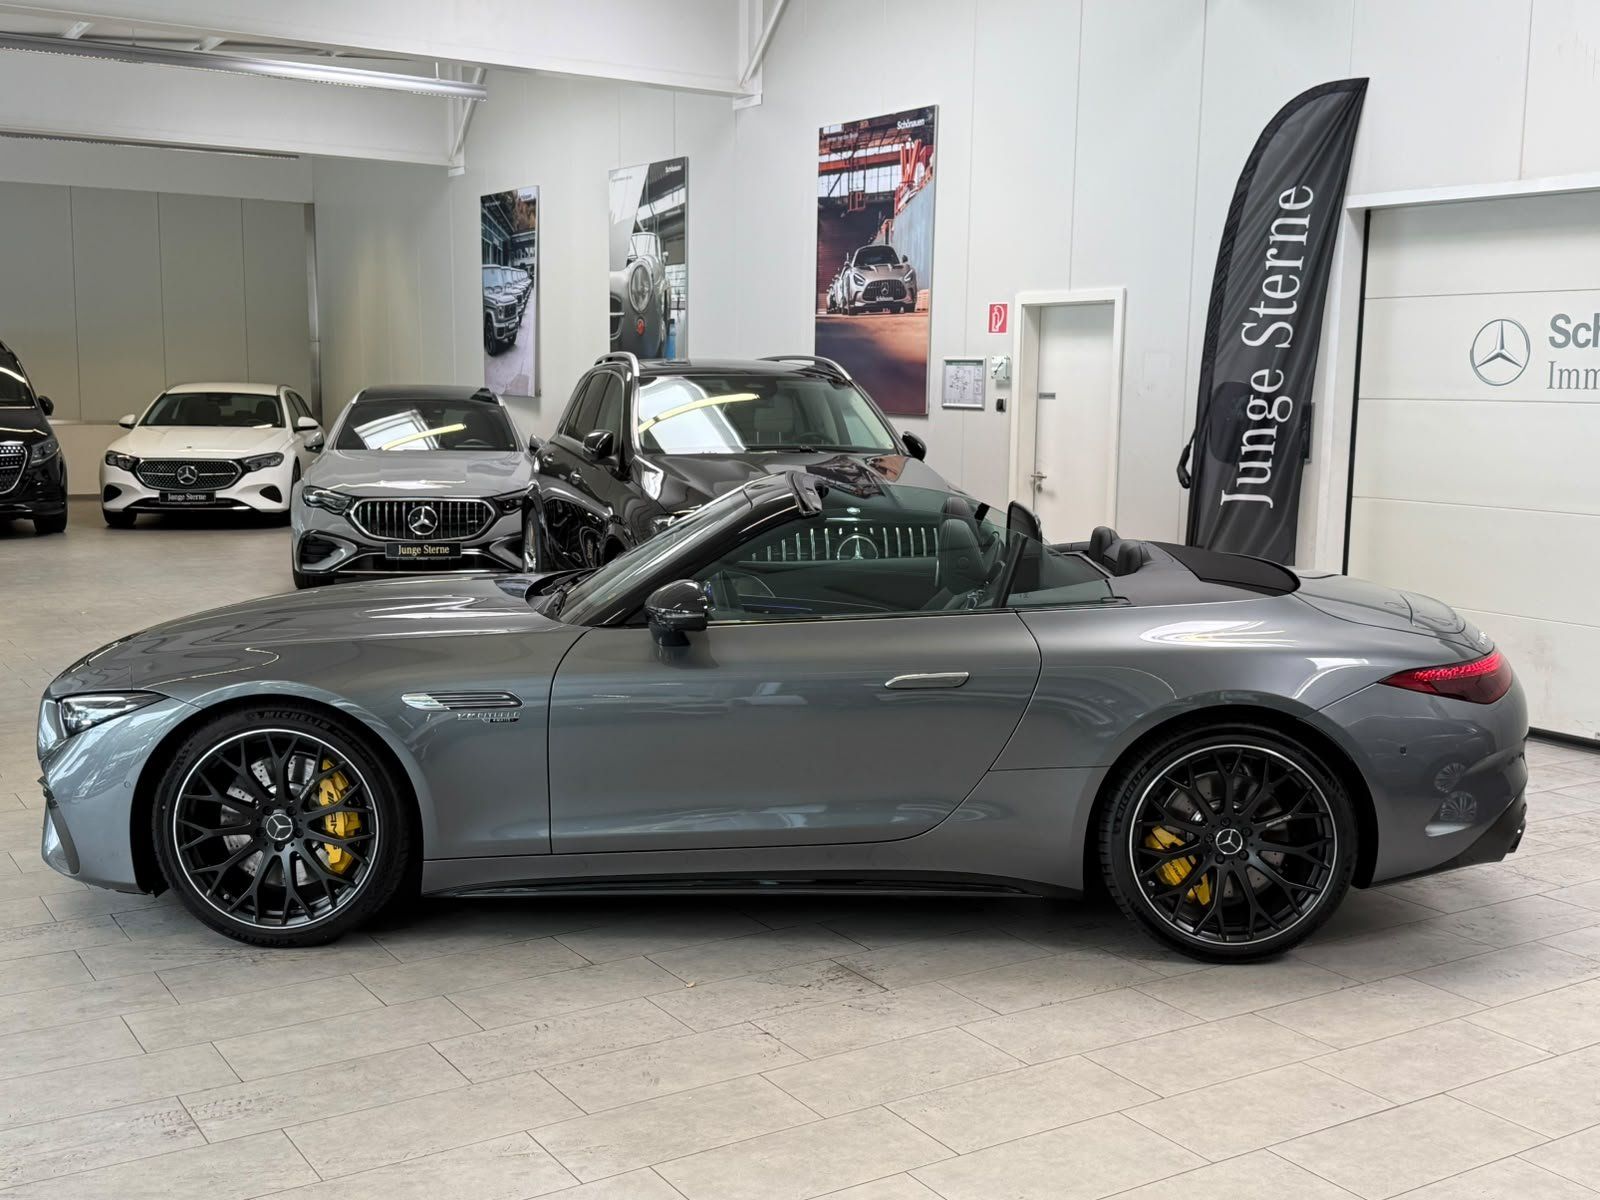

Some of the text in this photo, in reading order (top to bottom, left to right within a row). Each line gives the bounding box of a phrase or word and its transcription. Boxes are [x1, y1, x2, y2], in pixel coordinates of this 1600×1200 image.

[1220, 185, 1314, 508] Junge Sterne
[398, 544, 450, 557] Junge Sterne
